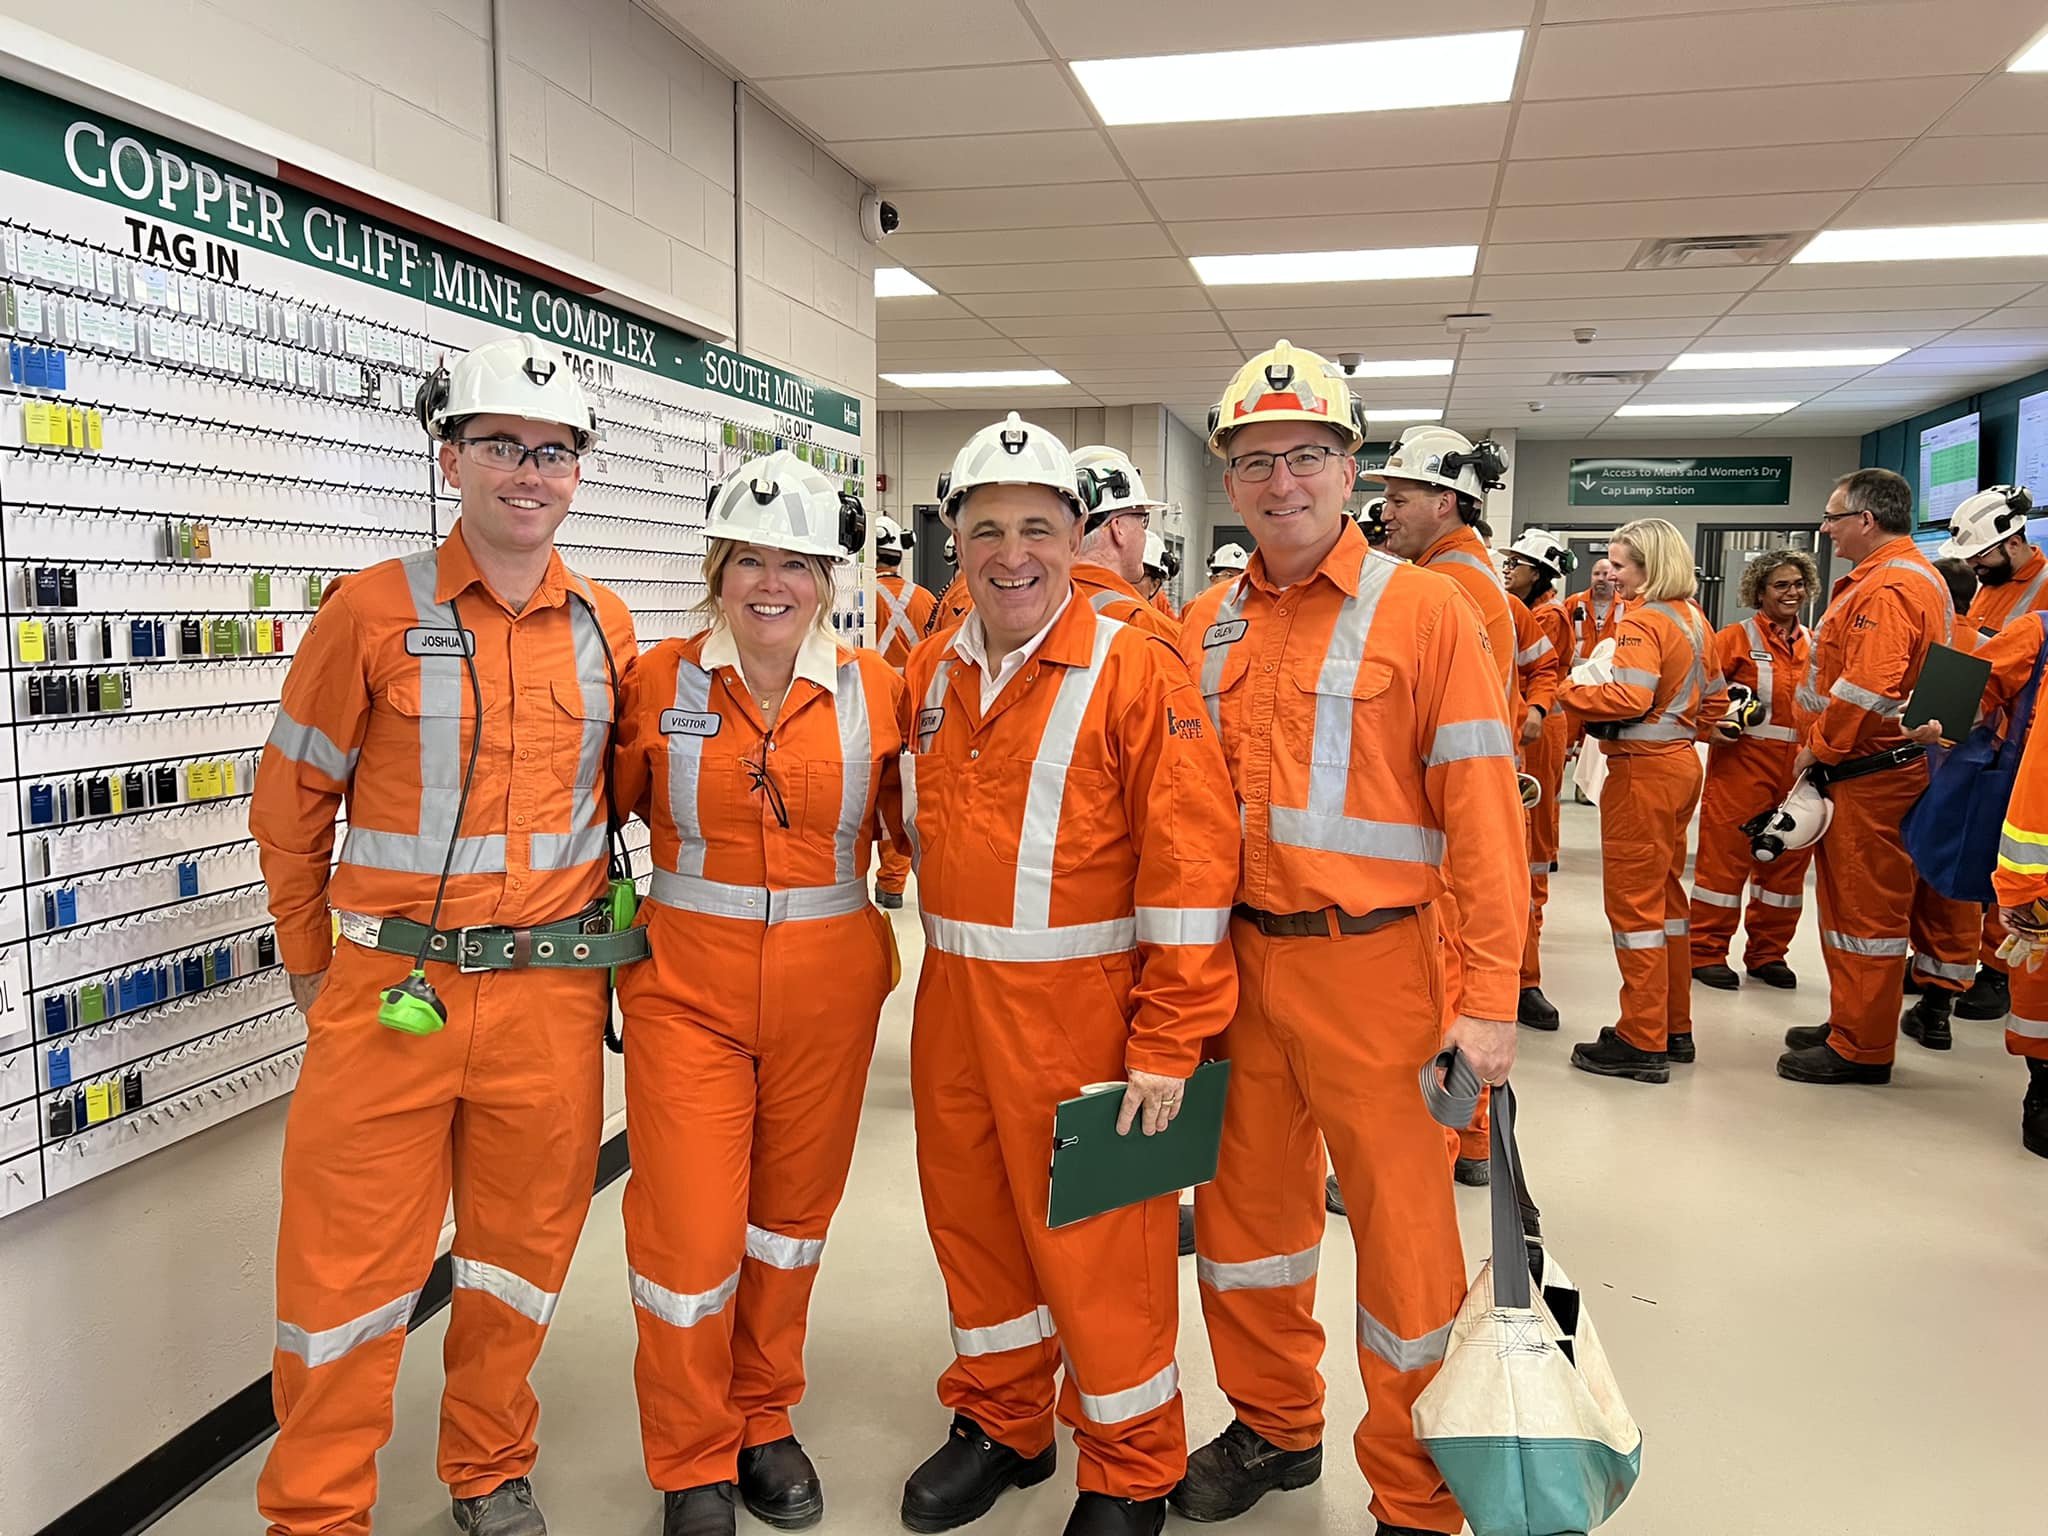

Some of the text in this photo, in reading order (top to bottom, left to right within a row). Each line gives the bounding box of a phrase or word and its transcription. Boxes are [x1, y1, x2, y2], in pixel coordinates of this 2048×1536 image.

[125, 216, 197, 268] TAG
[206, 241, 239, 281] IN
[64, 121, 290, 248] COPPER
[303, 206, 418, 288] CLIFF
[431, 251, 522, 324] MINE
[531, 290, 657, 367] COMPLEX
[706, 350, 770, 402] SOUTH
[774, 375, 815, 417] MINE
[562, 351, 613, 385] TAG IN
[773, 414, 812, 440] TAG OUT
[1602, 466, 1781, 479] Access to Men's and Women's Dry
[1601, 485, 1695, 497] Cap Lamp Station
[421, 635, 460, 648] JOSHUA
[672, 717, 706, 729] VISITOR
